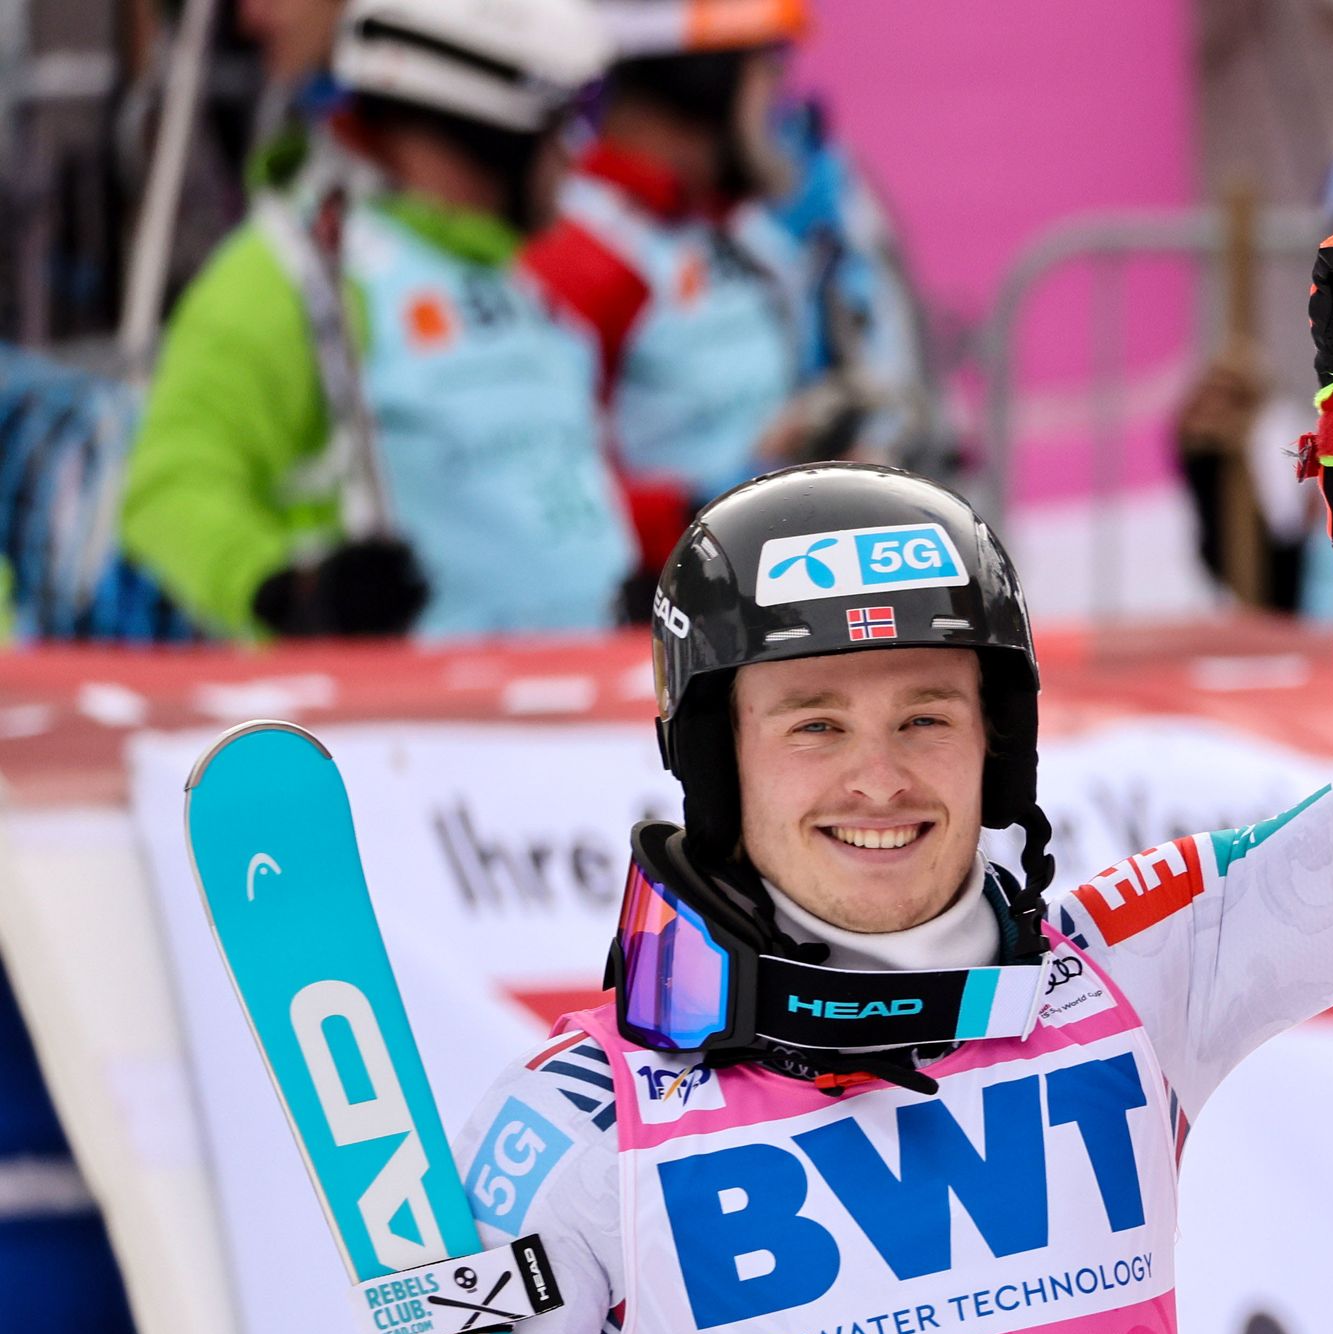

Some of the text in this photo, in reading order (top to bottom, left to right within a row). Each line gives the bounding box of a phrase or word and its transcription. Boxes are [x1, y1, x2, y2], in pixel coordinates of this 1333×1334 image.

[869, 537, 943, 575] 5G
[653, 585, 690, 639] EAD
[787, 994, 924, 1020] HEAD
[479, 1120, 547, 1217] 5G
[657, 1051, 1148, 1330] BWT
[365, 1273, 440, 1309] REBELS
[524, 1247, 550, 1302] HEAD
[947, 1252, 1153, 1322] TECHNOLOGY
[373, 1299, 433, 1331] CLUB.
